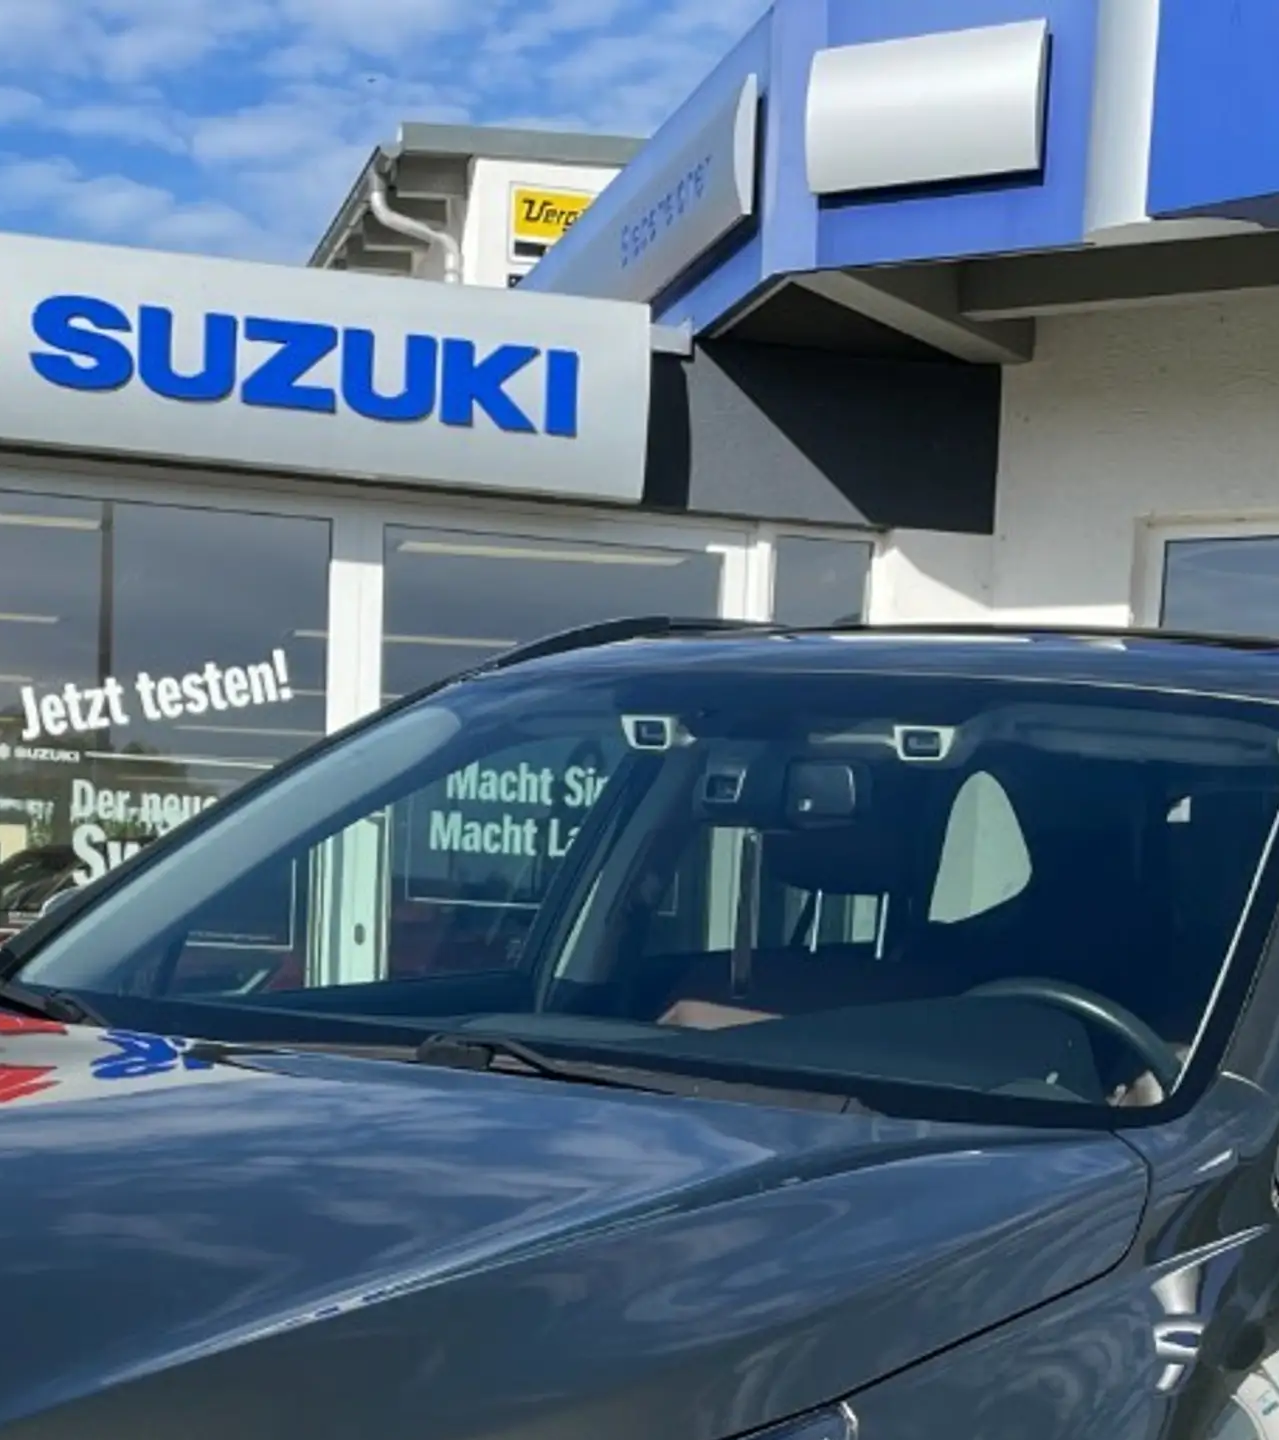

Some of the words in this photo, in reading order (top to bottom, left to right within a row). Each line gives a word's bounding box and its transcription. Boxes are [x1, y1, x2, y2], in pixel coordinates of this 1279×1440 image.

[523, 198, 585, 232] Verg
[30, 295, 580, 437] SUZUKI
[20, 676, 130, 741] Jetzt
[135, 648, 294, 721] testen!
[14, 746, 80, 763] SUZUKI
[71, 777, 131, 822] Der
[446, 761, 554, 806] Macht
[429, 810, 538, 857] Macht
